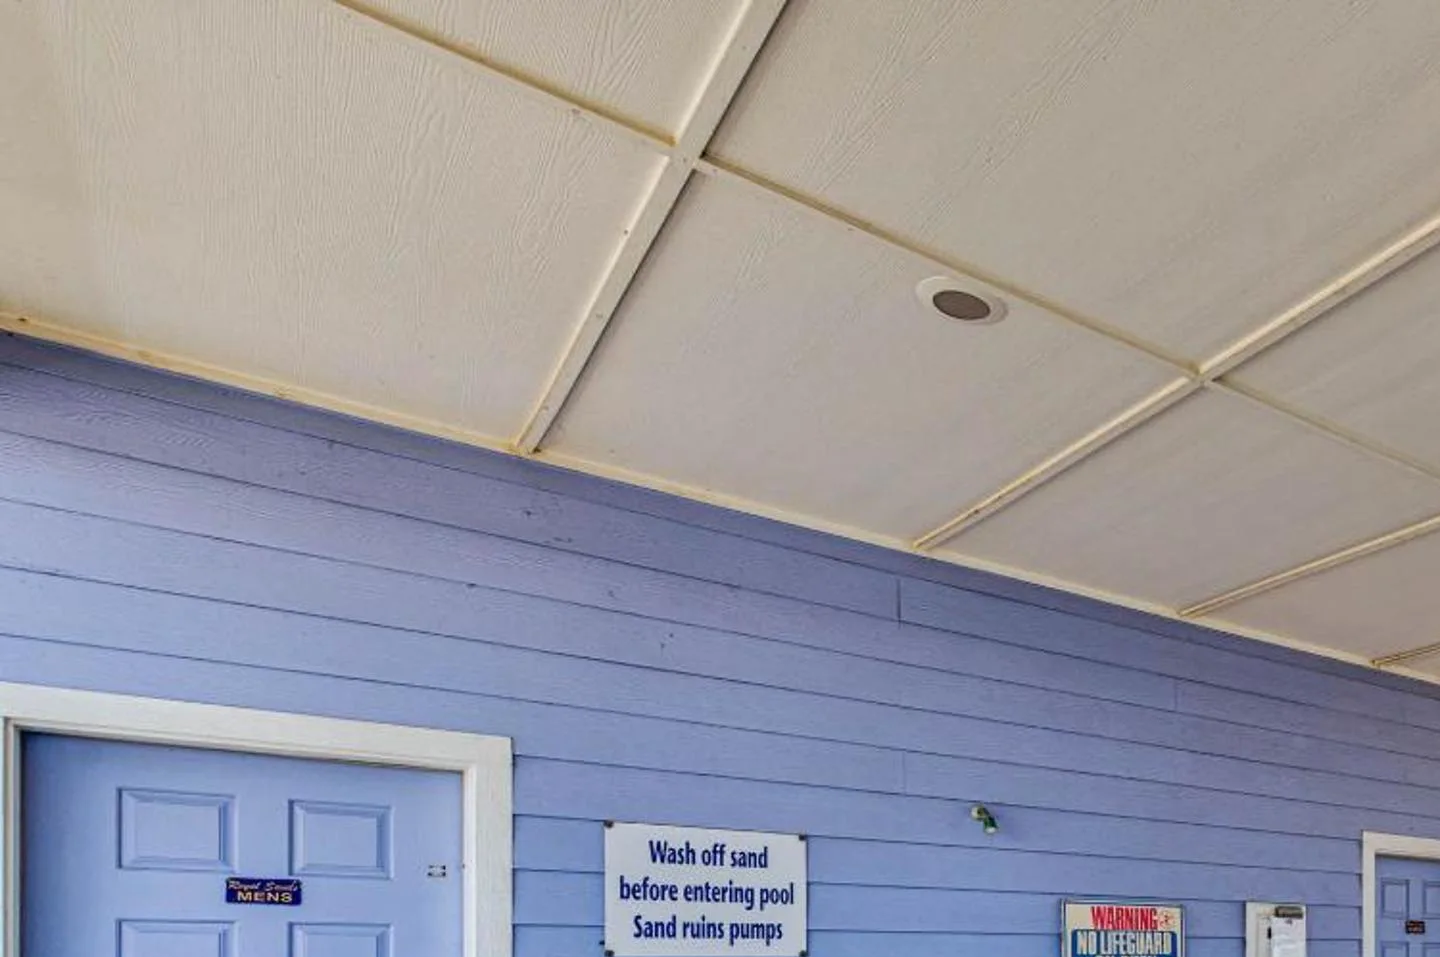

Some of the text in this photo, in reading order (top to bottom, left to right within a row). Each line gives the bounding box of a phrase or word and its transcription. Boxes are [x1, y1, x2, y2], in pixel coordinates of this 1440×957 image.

[649, 840, 768, 868] Wash off sand
[237, 891, 293, 903] MENS
[619, 875, 795, 911] before entering pool
[633, 915, 783, 946] Sand ruins pumps
[1091, 906, 1158, 931] WARNING
[1076, 931, 1172, 956] NO LIFEGUARD
